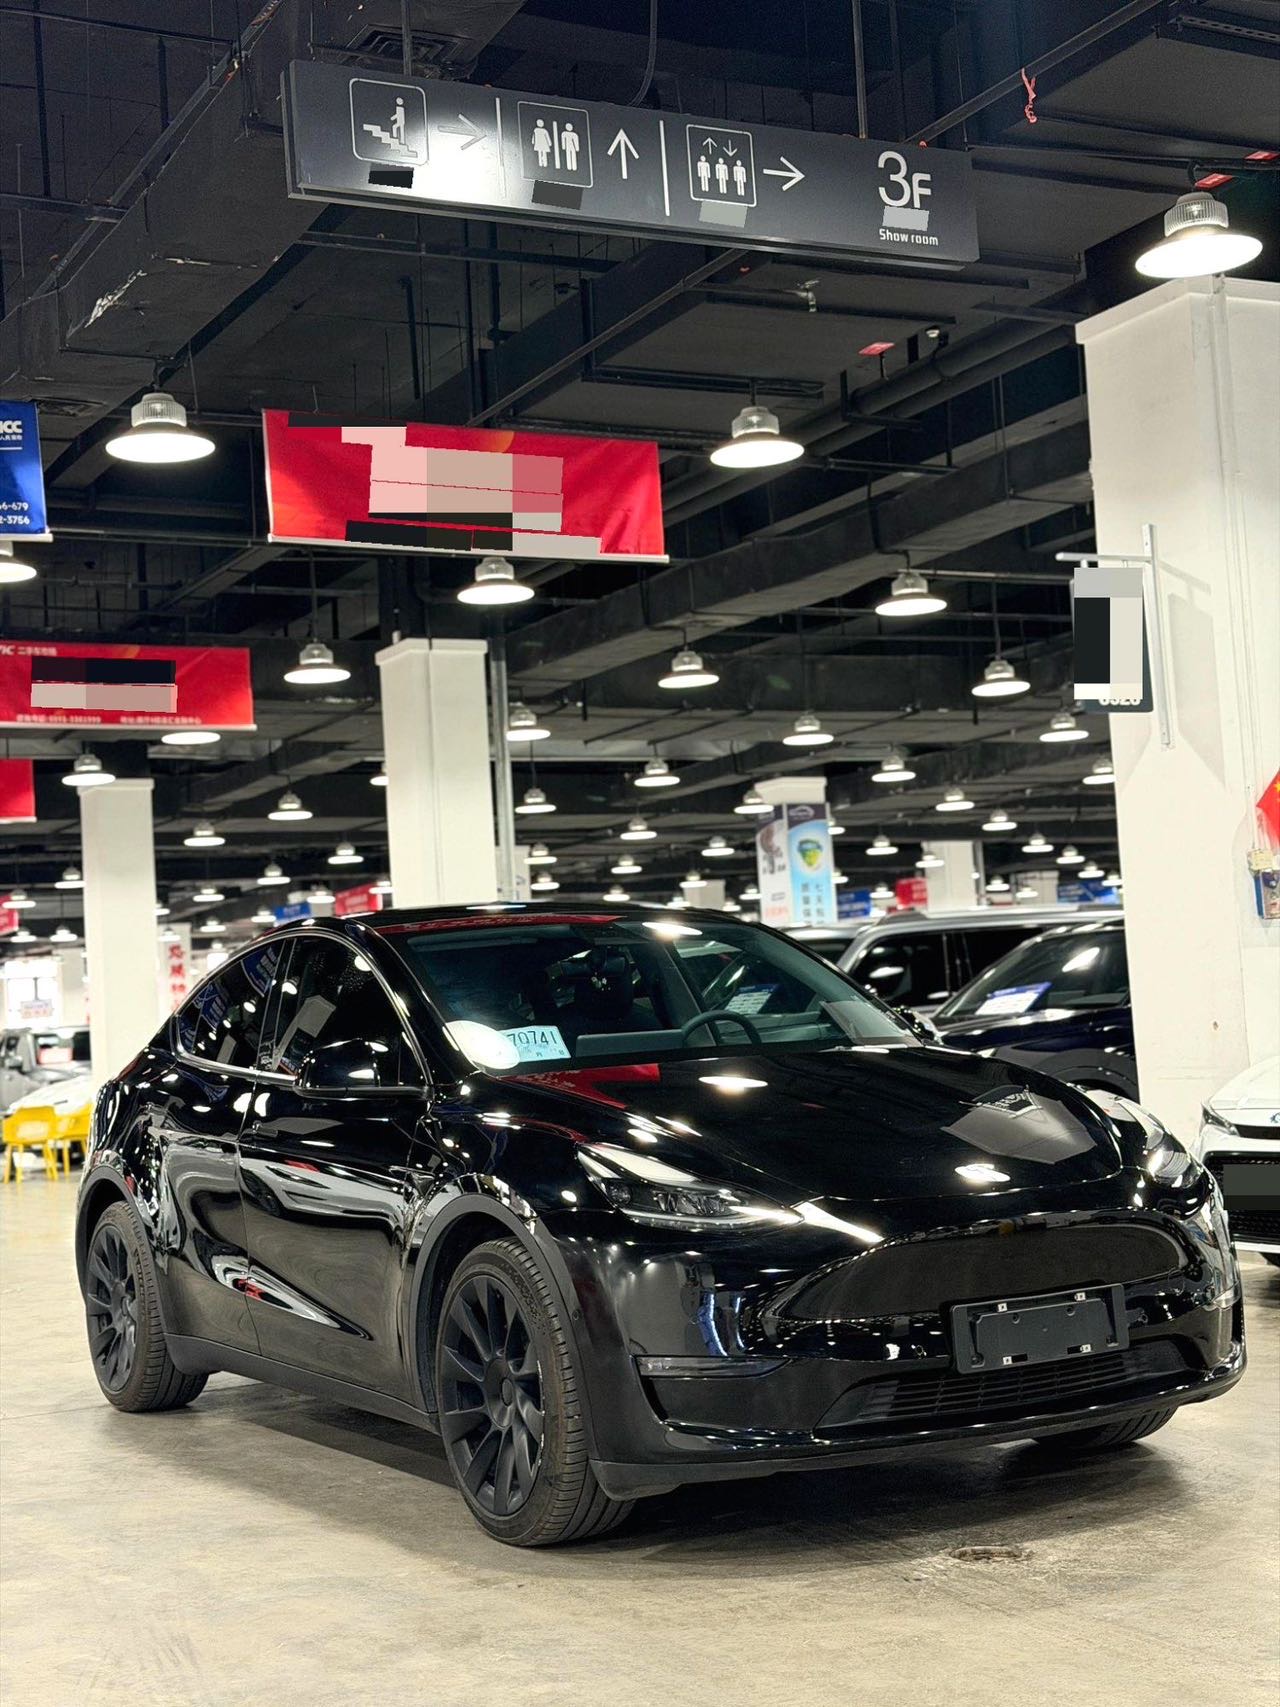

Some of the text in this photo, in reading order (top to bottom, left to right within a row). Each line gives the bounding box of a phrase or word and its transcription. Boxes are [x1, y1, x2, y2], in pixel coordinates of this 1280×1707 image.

[878, 151, 932, 208] 3F
[879, 229, 939, 246] Show room
